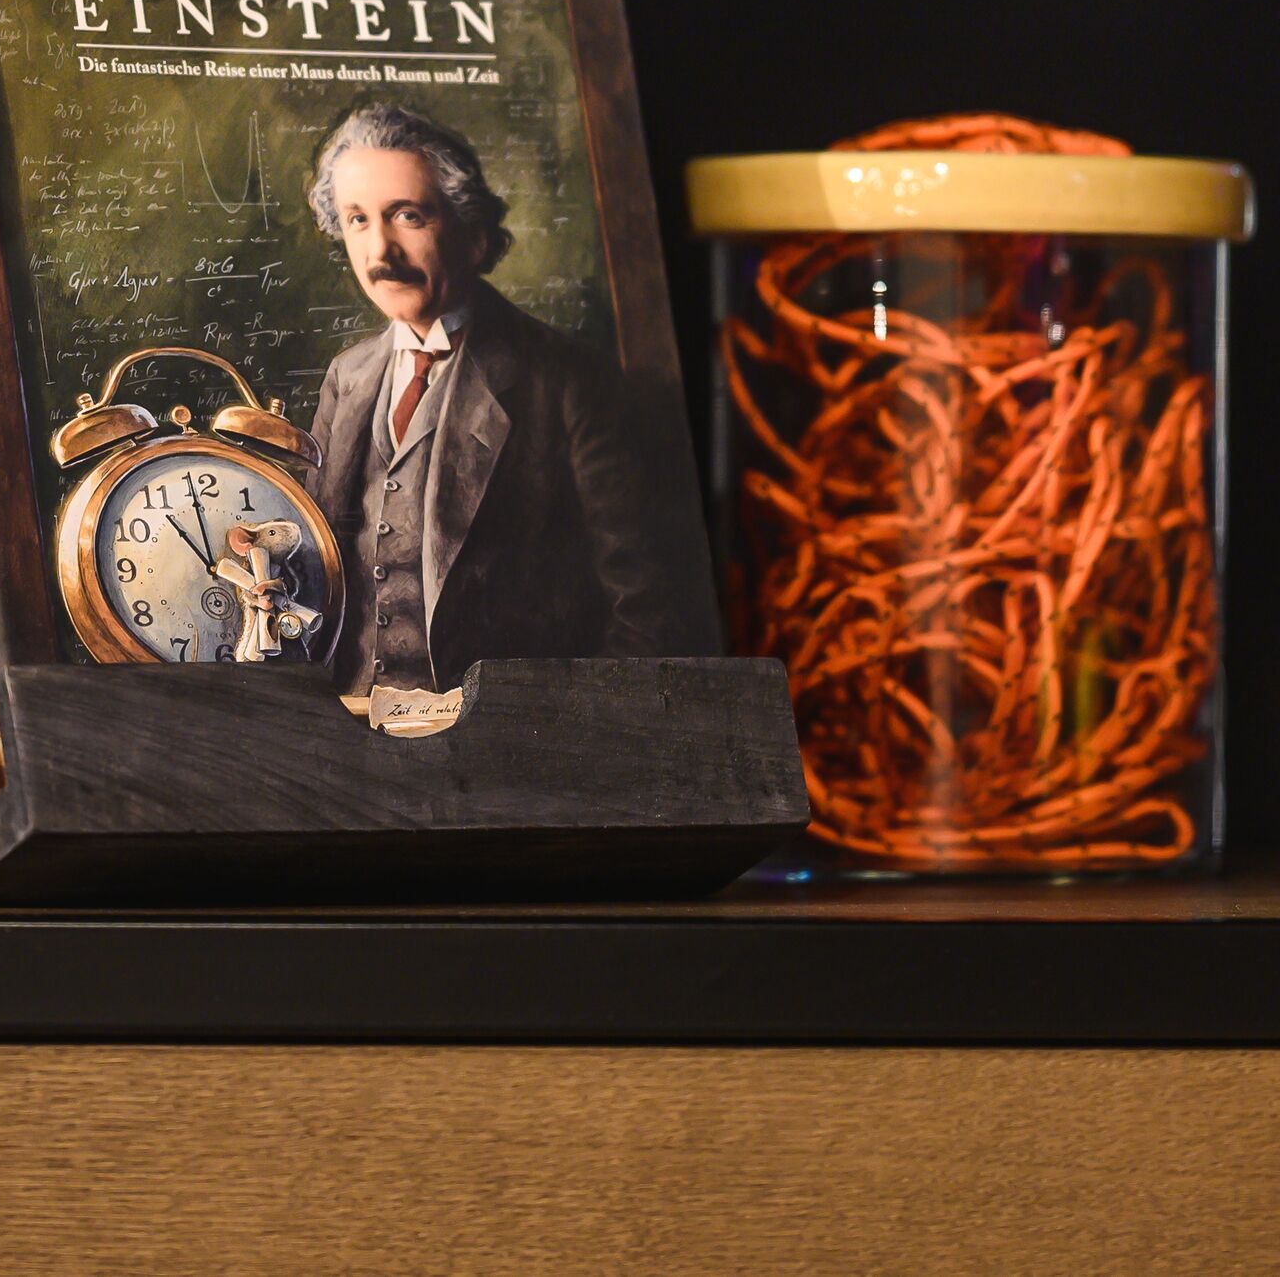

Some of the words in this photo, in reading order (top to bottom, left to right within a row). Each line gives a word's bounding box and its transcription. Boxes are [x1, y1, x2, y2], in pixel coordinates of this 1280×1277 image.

[78, 56, 108, 72] Die
[111, 57, 201, 76] fantastische
[204, 60, 246, 77] Reise
[249, 63, 288, 78] einer
[290, 63, 335, 79] Maus
[337, 64, 381, 81] durch
[384, 65, 431, 82] Raum
[434, 67, 464, 83] und
[467, 67, 500, 84] Zeit
[139, 484, 174, 510] 11
[181, 473, 220, 498] 12
[239, 487, 256, 512] 1
[114, 518, 151, 543] 10
[116, 558, 137, 583] 9
[131, 600, 154, 627] 8
[170, 637, 191, 662] 7
[387, 703, 412, 717] Zeit
[418, 705, 432, 715] ist
